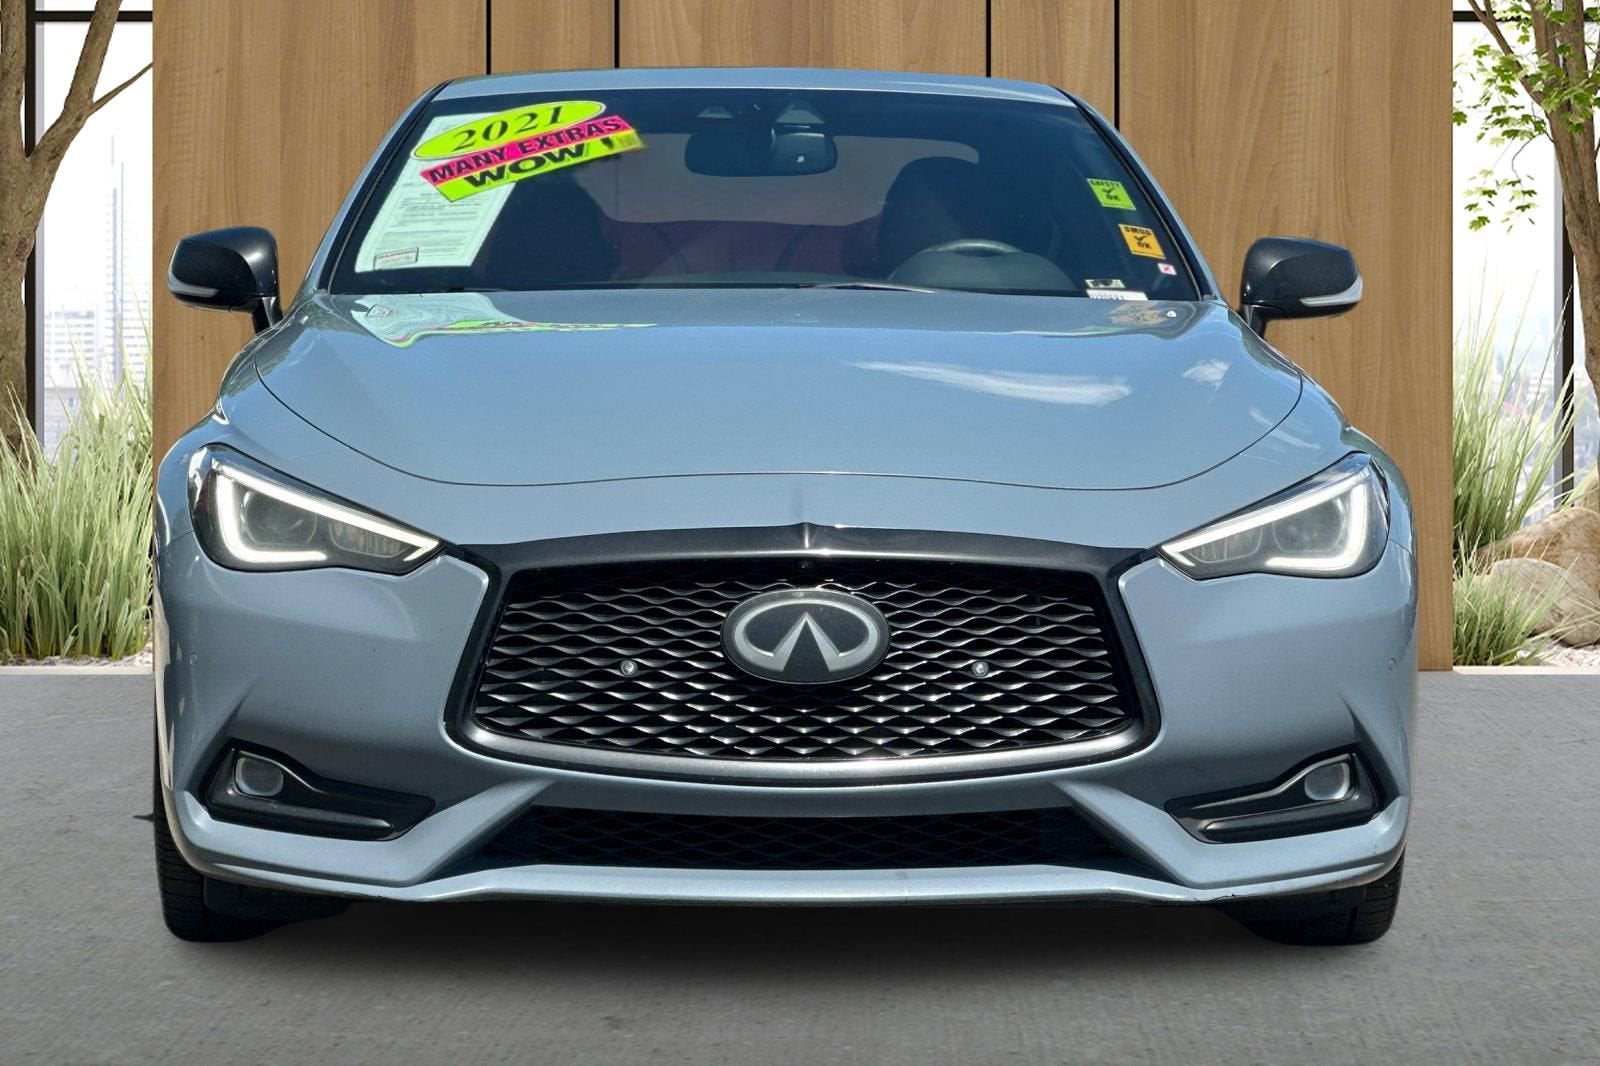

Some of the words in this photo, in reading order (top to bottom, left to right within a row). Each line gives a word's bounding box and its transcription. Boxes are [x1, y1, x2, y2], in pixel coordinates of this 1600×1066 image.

[429, 147, 507, 183] MANY
[520, 118, 621, 154] EXTRAS
[452, 106, 564, 151] 2021
